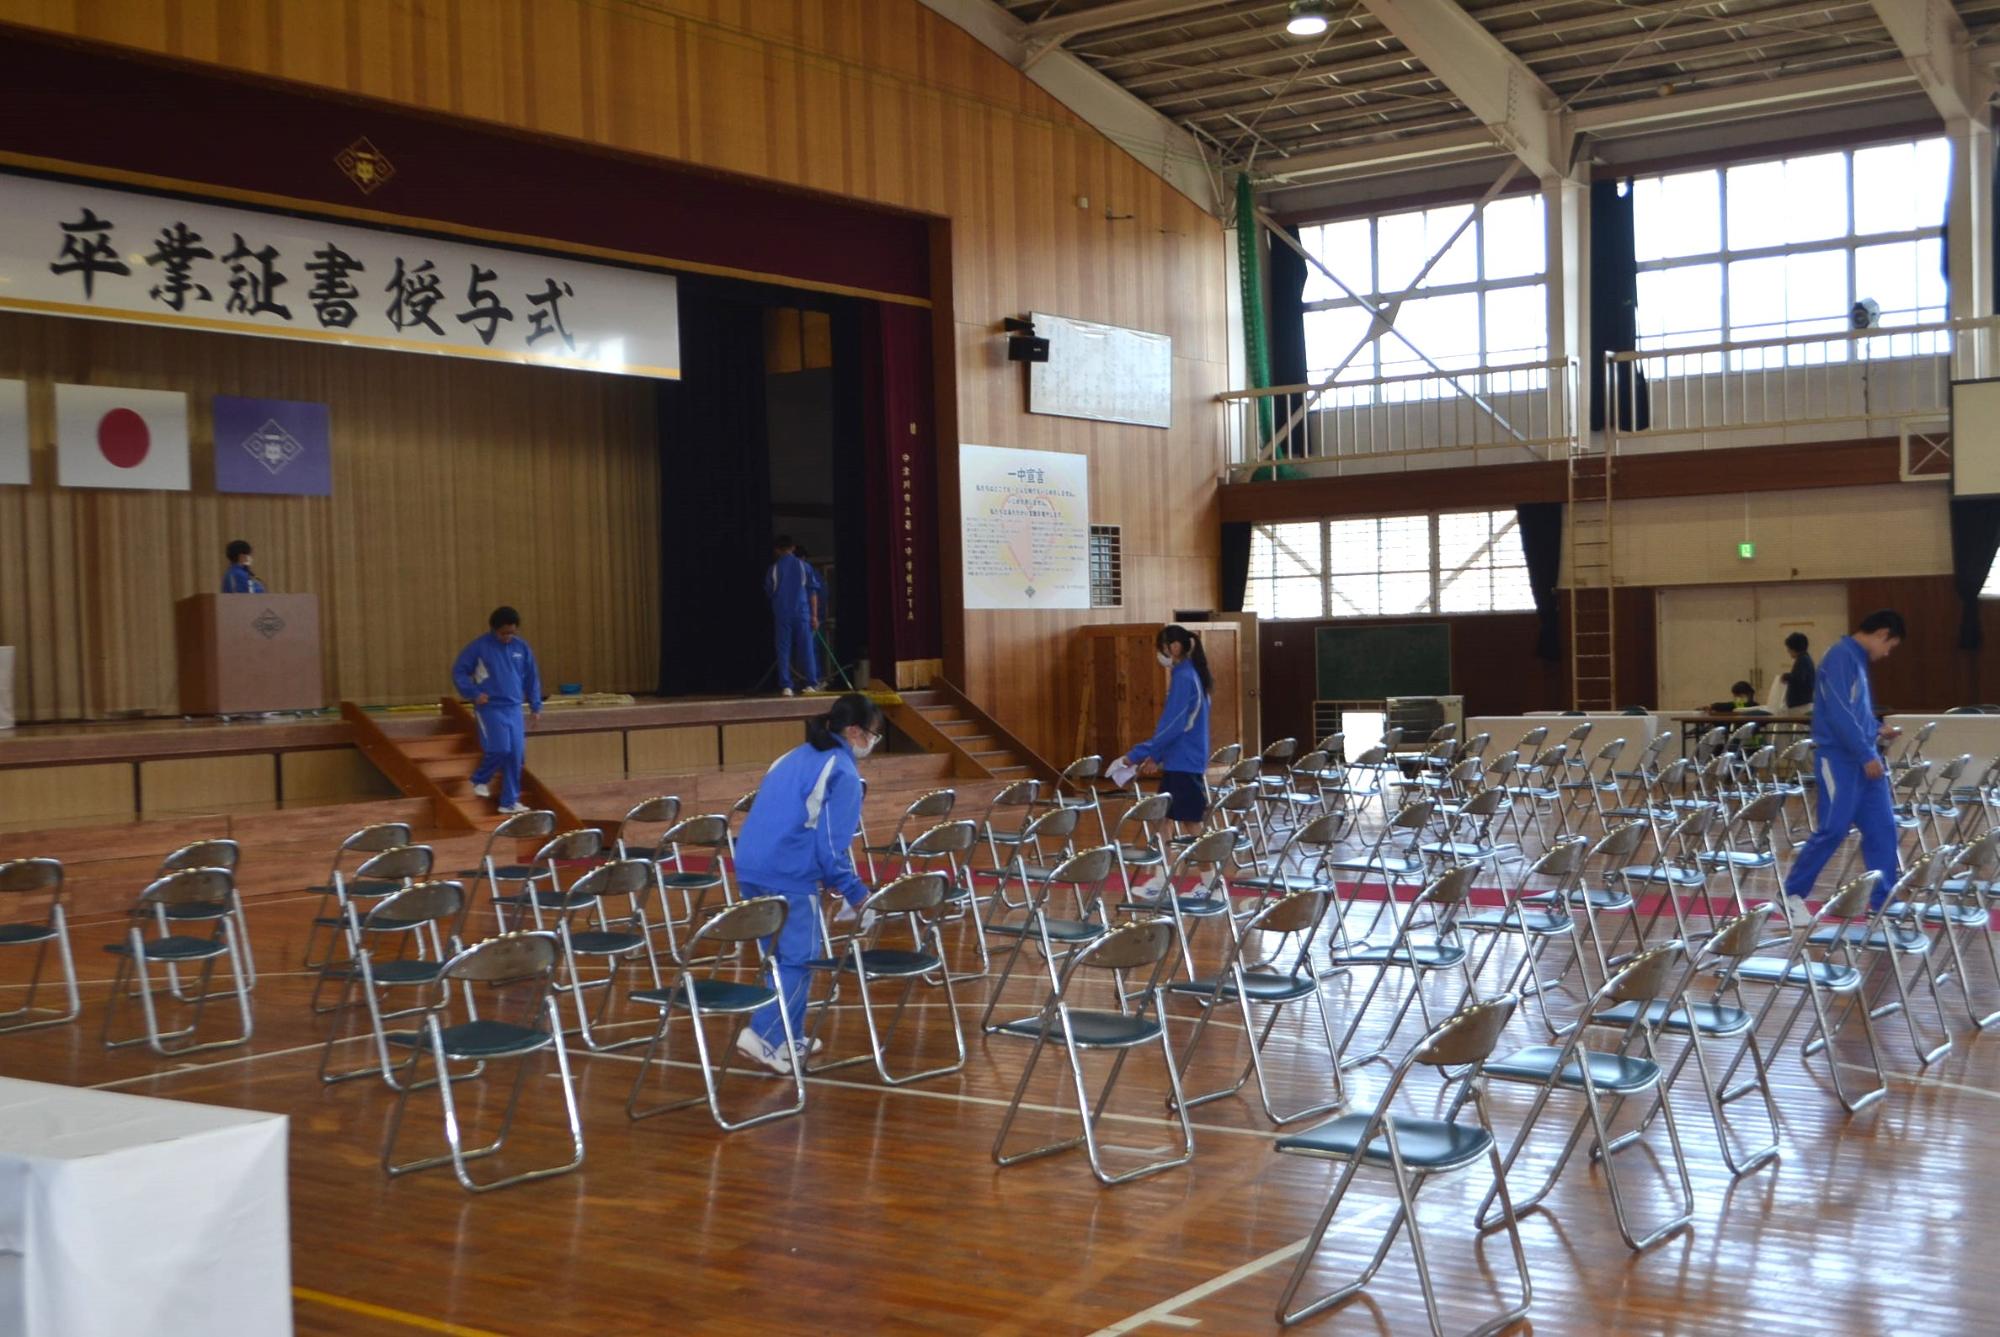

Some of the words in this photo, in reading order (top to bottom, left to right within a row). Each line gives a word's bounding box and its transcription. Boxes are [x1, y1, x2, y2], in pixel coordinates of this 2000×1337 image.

[50, 208, 577, 352] 卒業証書授与式
[1008, 467, 1045, 484] 一中宣言
